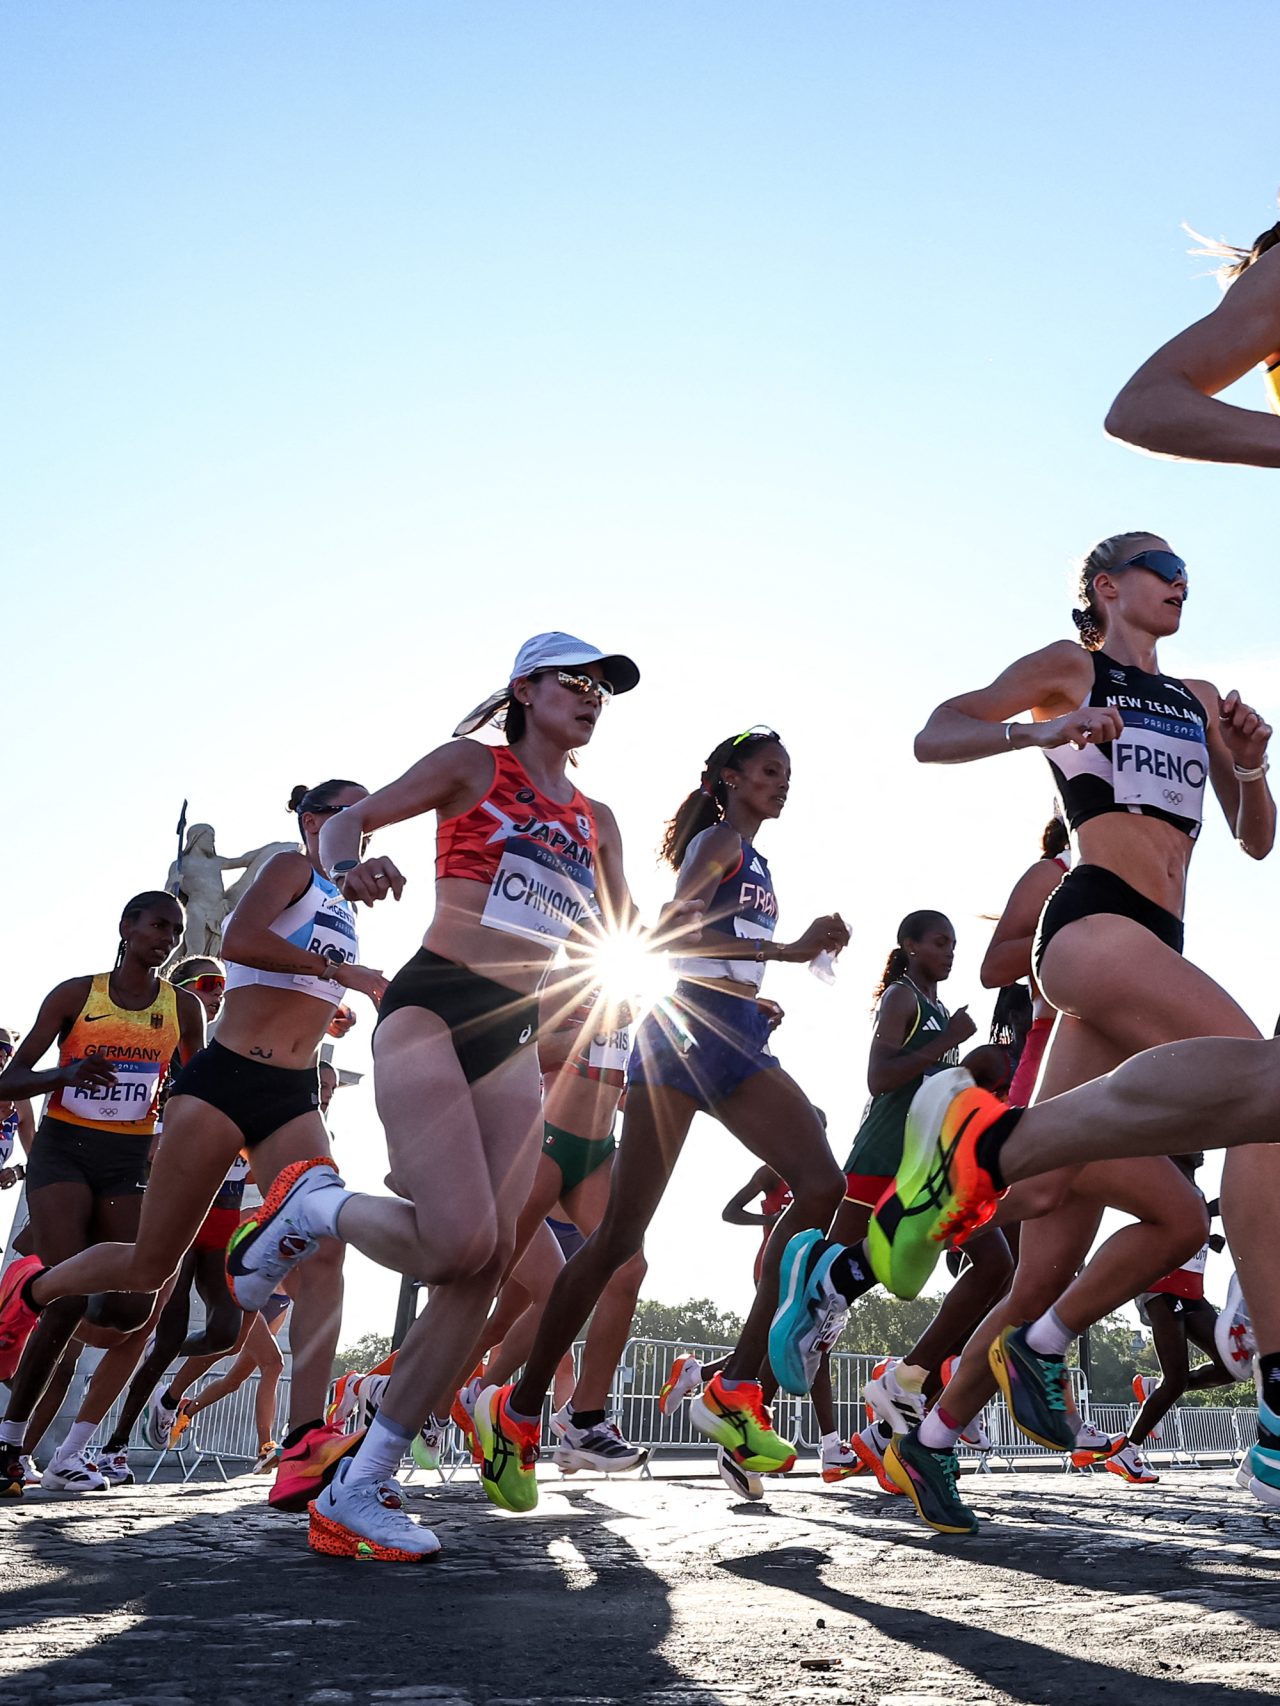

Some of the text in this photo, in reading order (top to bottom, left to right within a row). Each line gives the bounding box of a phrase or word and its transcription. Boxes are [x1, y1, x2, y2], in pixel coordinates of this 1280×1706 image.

[1106, 695, 1142, 709] NEW
[1144, 717, 1171, 732] PARIS
[513, 815, 593, 869] JAPAN
[84, 1044, 161, 1060] GERMANY
